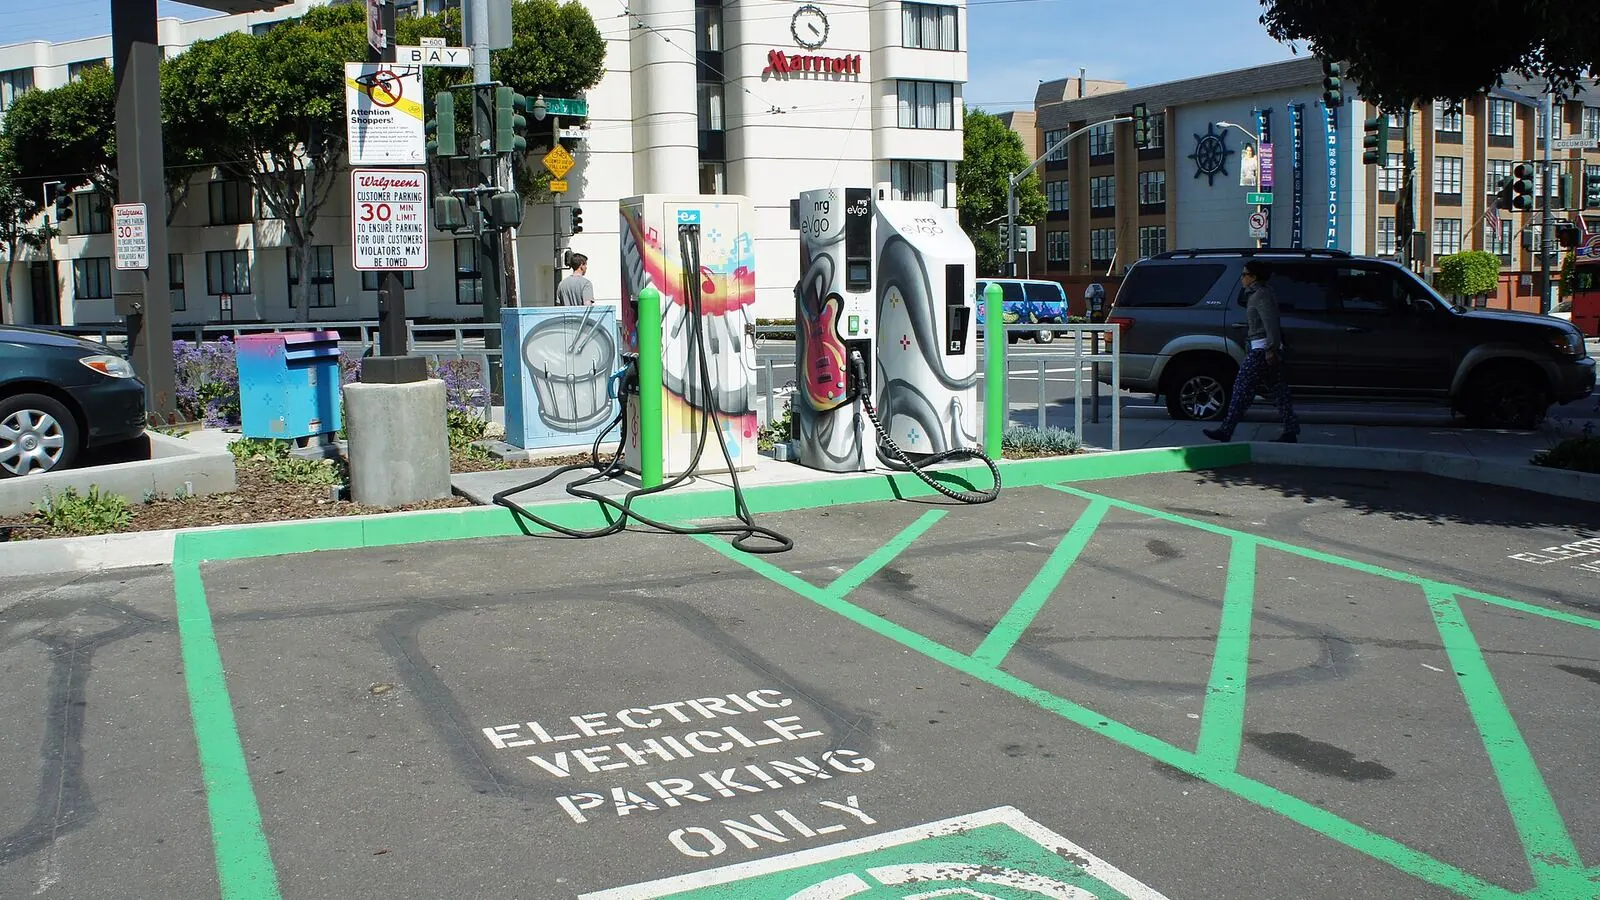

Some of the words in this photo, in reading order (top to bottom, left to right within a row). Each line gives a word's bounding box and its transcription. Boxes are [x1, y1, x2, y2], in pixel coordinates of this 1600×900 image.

[411, 50, 457, 62] BAY
[763, 49, 862, 74] Marriott
[1293, 111, 1301, 148] PIER
[1325, 107, 1336, 145] PIER
[1557, 140, 1594, 148] COLUMBUS
[359, 176, 421, 191] Walgreens
[357, 192, 391, 201] CUSTOMER
[394, 192, 422, 202] PARKING
[857, 199, 868, 207] nrg
[360, 203, 392, 222] 30
[814, 199, 830, 214] nrg
[847, 206, 868, 217] eVgo
[801, 215, 830, 238] eVgo
[914, 216, 936, 225] nrg
[1326, 191, 1337, 249] HOTEL
[118, 226, 131, 238] 30
[358, 224, 366, 233] TO
[369, 224, 393, 233] ENSURE
[396, 224, 423, 233] PARKING
[901, 224, 944, 236] eVgo
[357, 235, 370, 244] FOR
[373, 235, 386, 244] OUR
[388, 235, 424, 244] CUSTOMERS
[360, 246, 400, 256] VIOLATORS
[405, 246, 421, 256] MAY
[374, 258, 383, 267] BE
[386, 258, 408, 267] TOWED
[481, 689, 793, 750] ELECTRIC
[526, 714, 825, 778] VEHICLE
[555, 749, 876, 825] PARKING
[667, 795, 878, 858] ONLY
